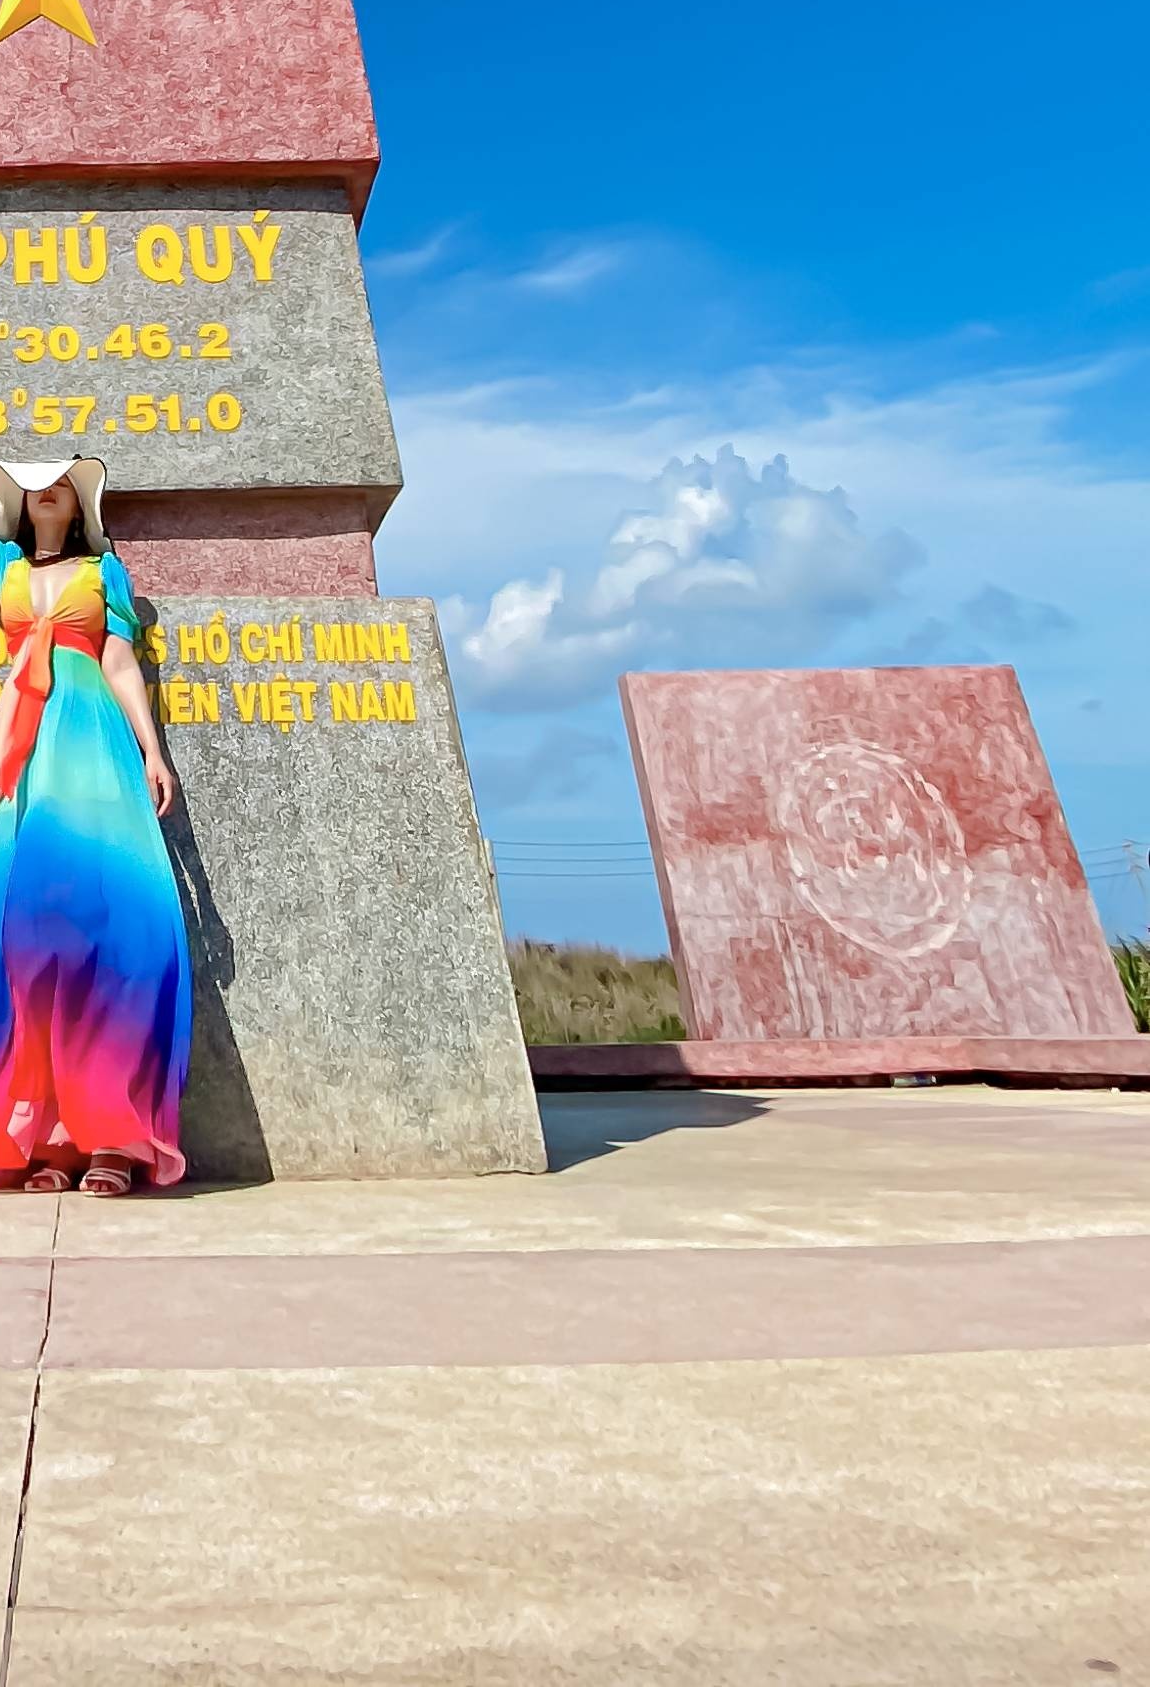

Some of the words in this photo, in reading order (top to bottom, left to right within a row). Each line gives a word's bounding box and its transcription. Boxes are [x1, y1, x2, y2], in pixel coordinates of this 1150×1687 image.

[134, 209, 282, 287] QUÝ
[239, 616, 304, 663] CHÍ
[313, 622, 411, 663] MINH
[231, 674, 318, 733] VIỆT
[330, 682, 417, 722] NAM
